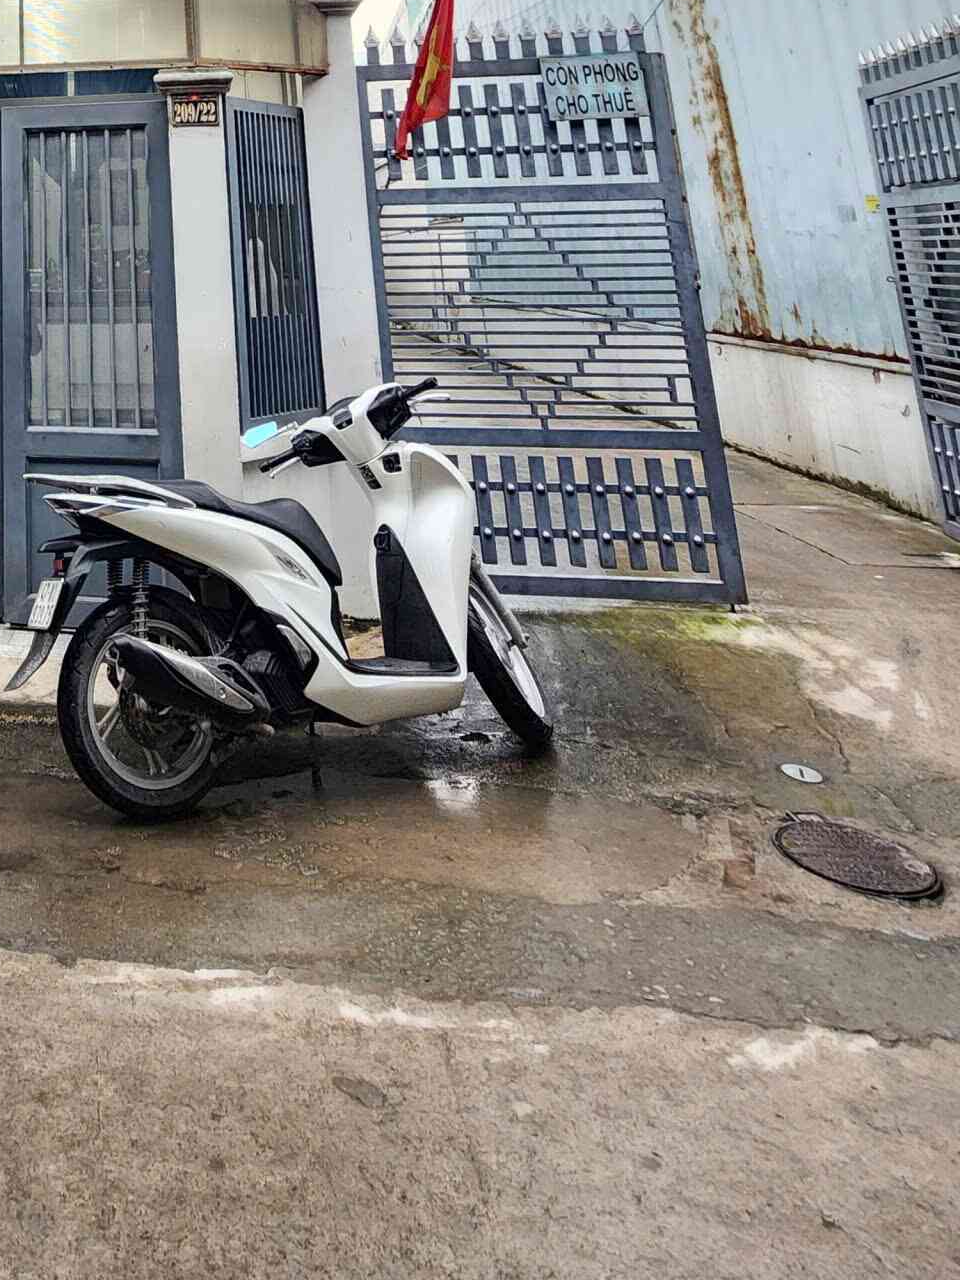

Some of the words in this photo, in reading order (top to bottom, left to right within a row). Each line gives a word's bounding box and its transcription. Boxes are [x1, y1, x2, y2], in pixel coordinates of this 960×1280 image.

[174, 102, 217, 122] 209/22
[555, 94, 589, 115] CHO
[592, 86, 636, 113] THUÊ
